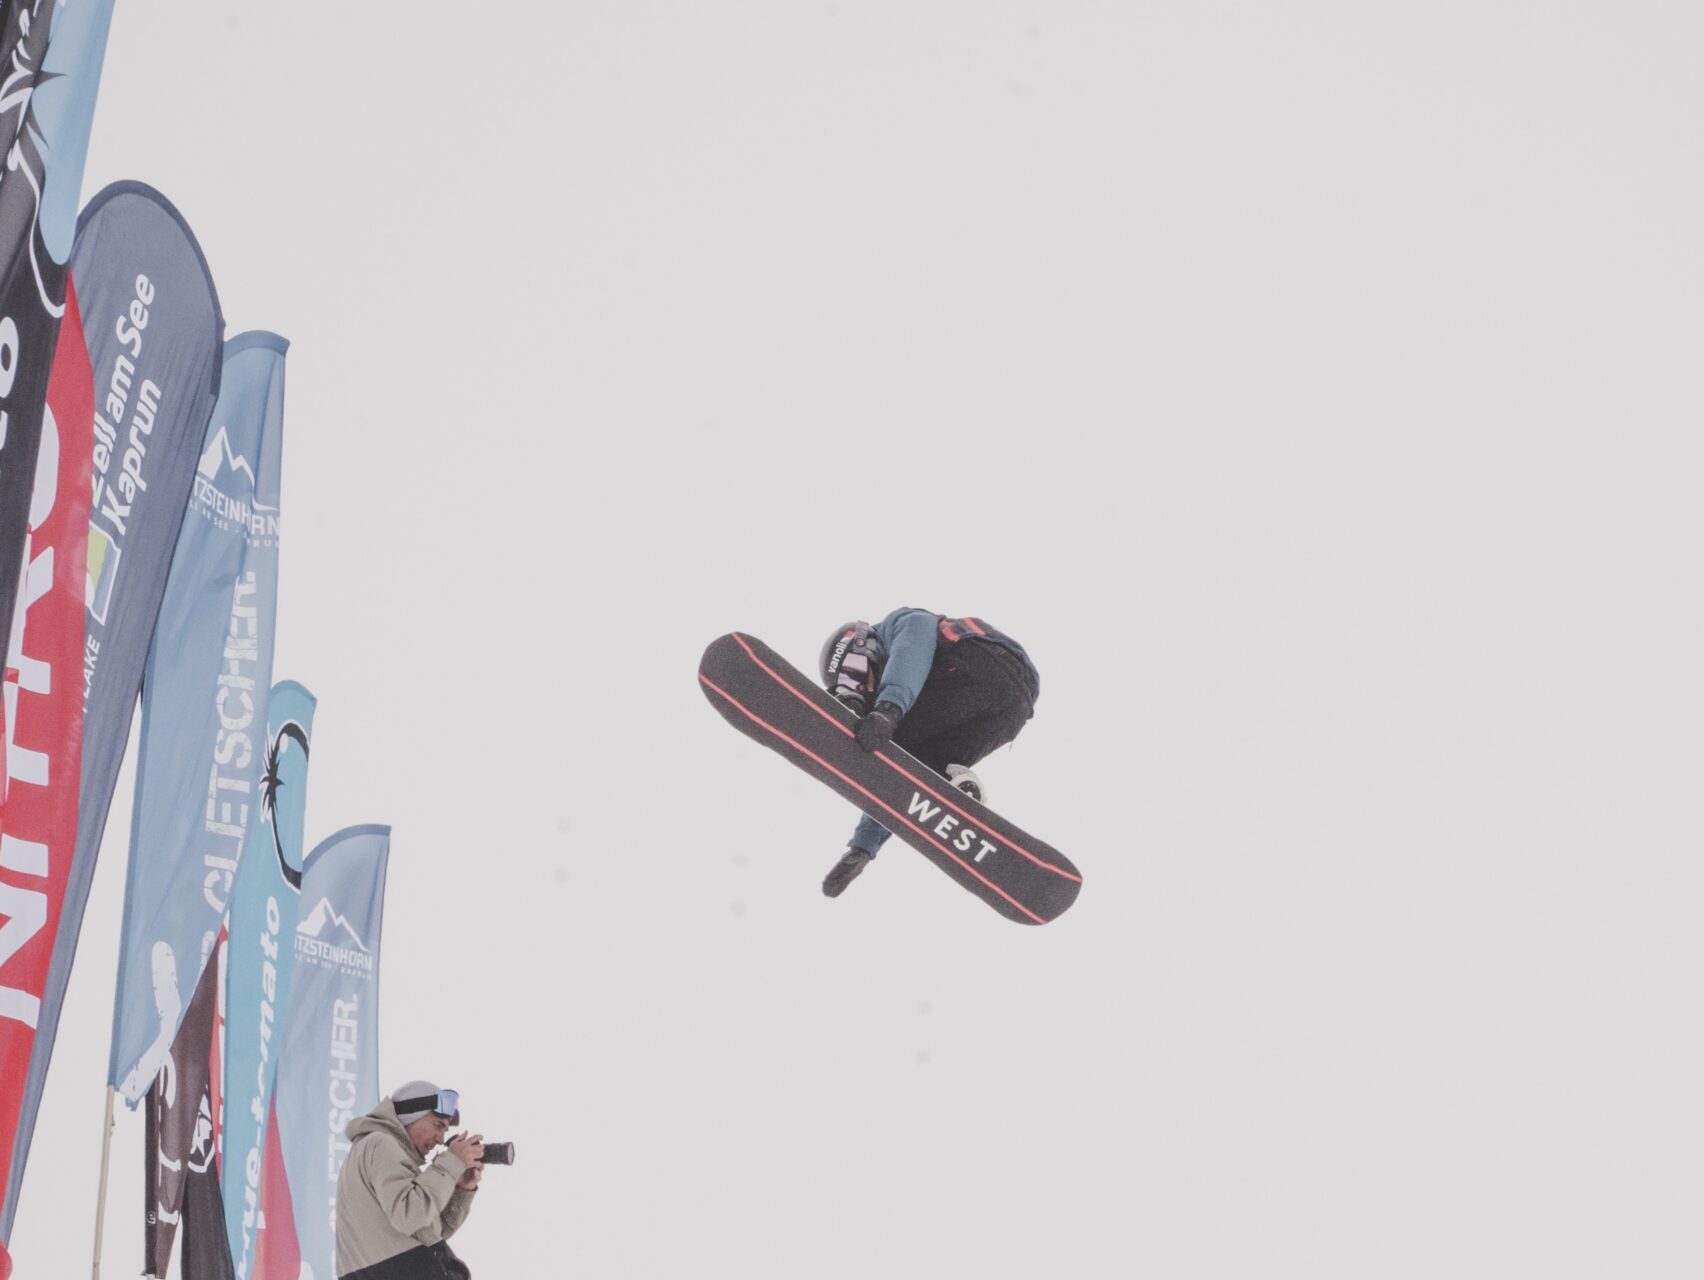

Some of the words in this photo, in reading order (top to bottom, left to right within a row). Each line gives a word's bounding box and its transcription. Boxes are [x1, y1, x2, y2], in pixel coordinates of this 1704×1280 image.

[115, 273, 155, 359] See
[106, 355, 135, 424] am
[101, 379, 162, 536] Kaprun
[828, 642, 848, 673] vanoli
[907, 791, 997, 863] WEST
